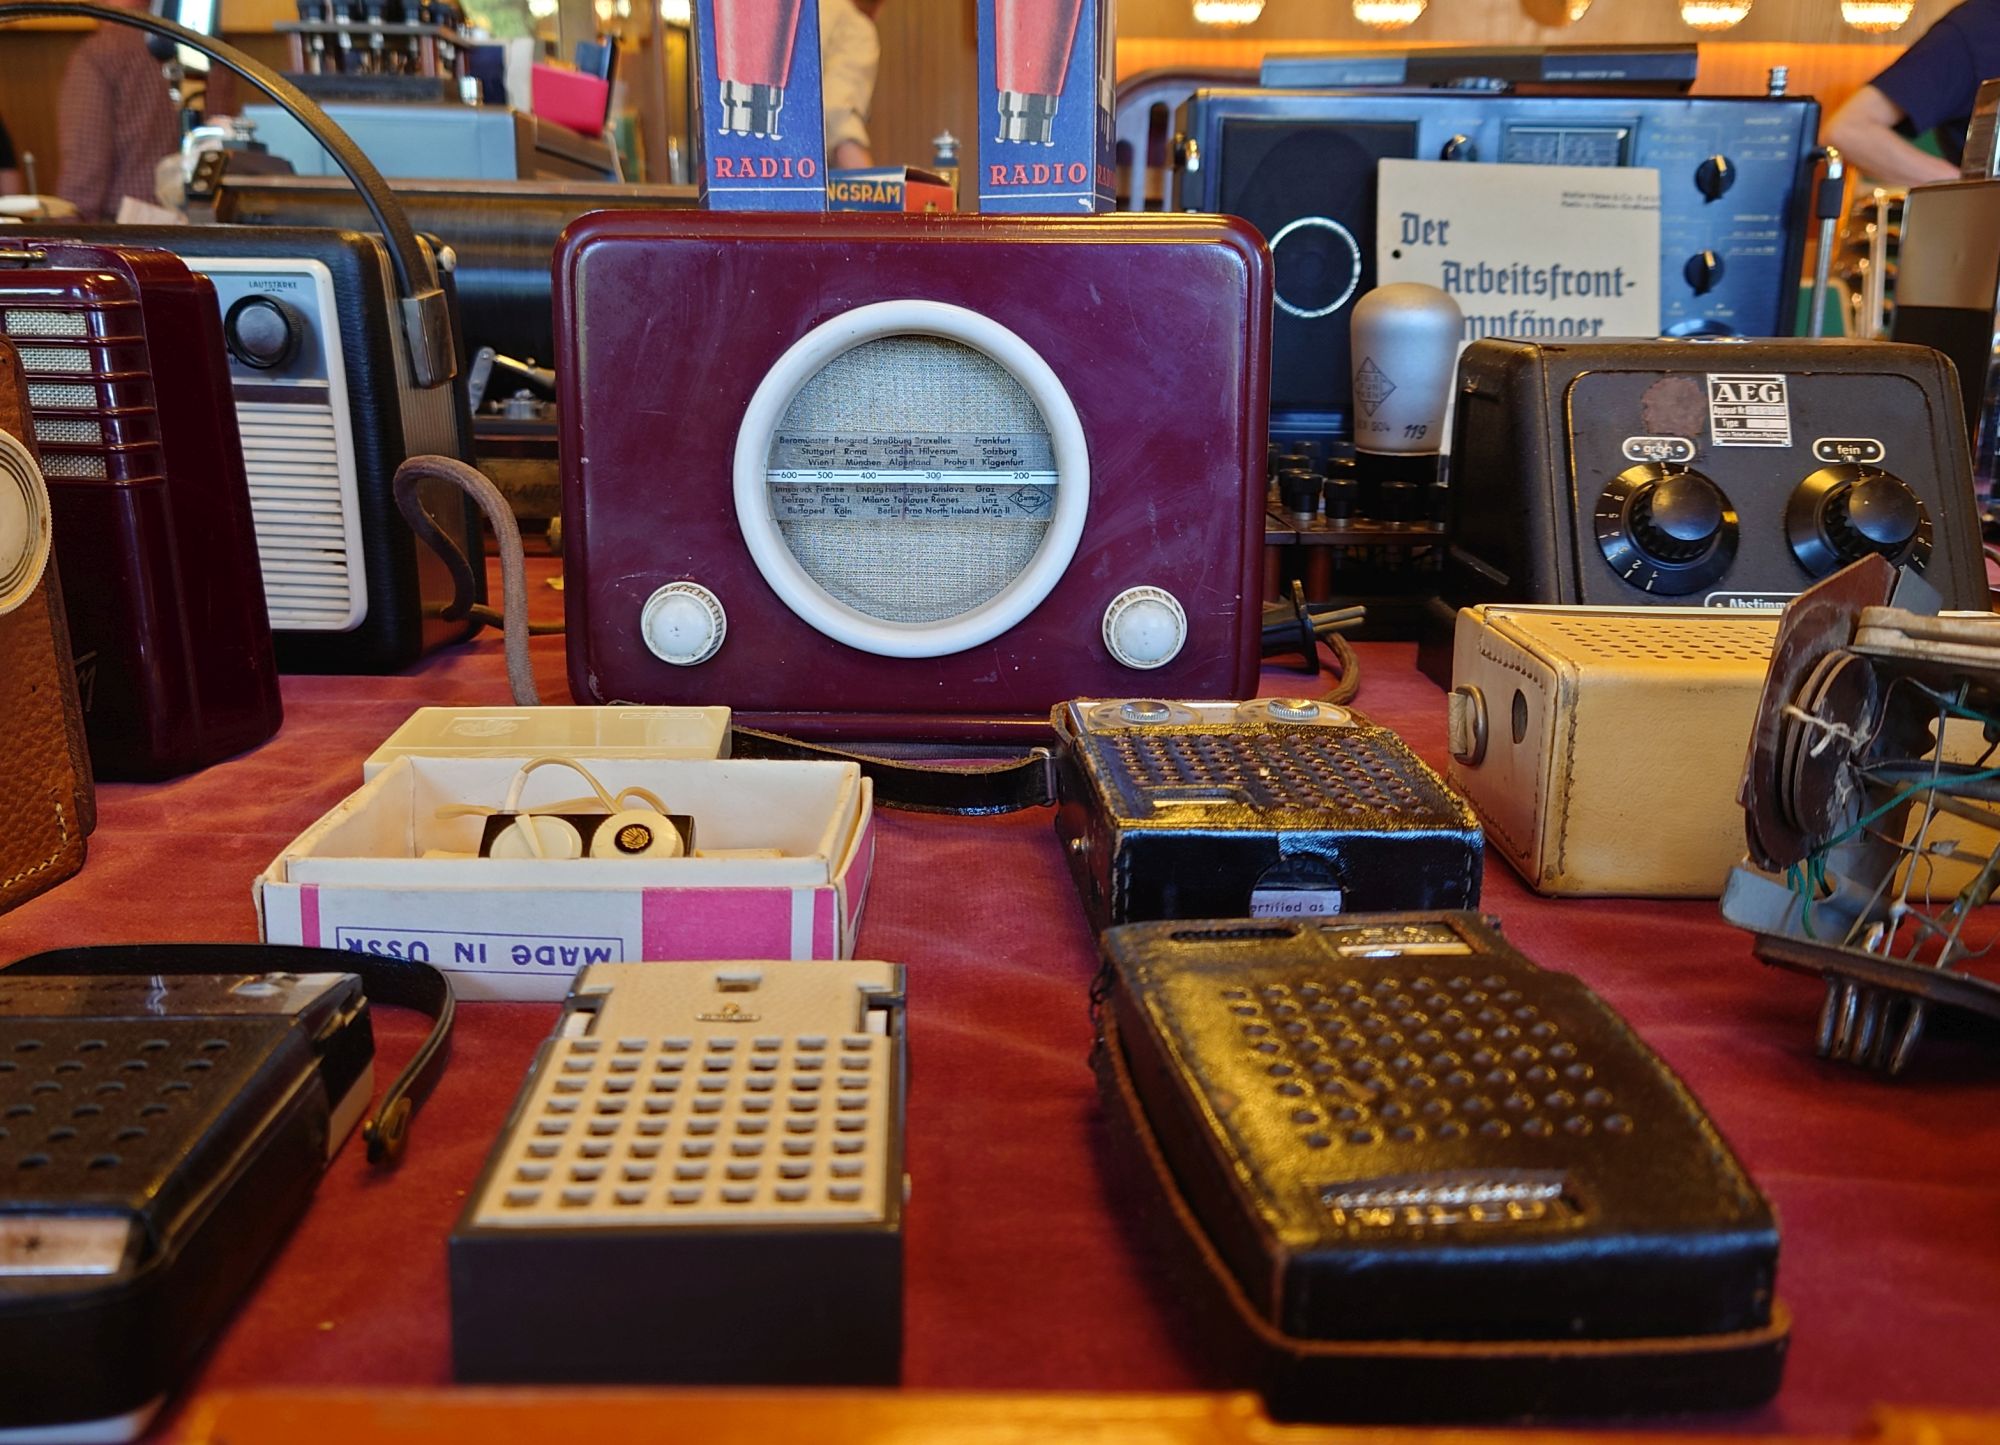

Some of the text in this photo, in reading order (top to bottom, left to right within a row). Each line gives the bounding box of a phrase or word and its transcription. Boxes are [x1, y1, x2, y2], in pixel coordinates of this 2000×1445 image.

[714, 156, 817, 180] RADIO
[989, 162, 1088, 187] RADIO
[827, 181, 900, 204] NGSRAM
[1400, 211, 1450, 247] Der
[1441, 260, 1636, 300] Arbeitsfront-
[1464, 309, 1604, 339] mpfänger
[1714, 383, 1781, 403] AEG
[1721, 418, 1739, 429] Type
[1404, 424, 1427, 439] 119
[975, 436, 1011, 444] Frankfurt
[801, 447, 1017, 456] Stuttgart Roma London Hilversum Salzburg
[1837, 444, 1861, 455] fein
[808, 458, 829, 466] Wien
[845, 458, 881, 466] München
[889, 458, 931, 468] Alpenland
[944, 458, 967, 466] Praha
[982, 458, 1024, 468] Klagenfurt
[781, 471, 1030, 480] 600 500 400 300 200
[975, 485, 995, 493] Graz
[893, 496, 928, 504] Toulouse
[788, 507, 825, 516] Budapest
[834, 507, 852, 515] Köln
[1632, 559, 1642, 569] 2
[1729, 598, 1786, 608] Abstimm
[1250, 902, 1302, 913] ertified
[455, 941, 488, 964] IN
